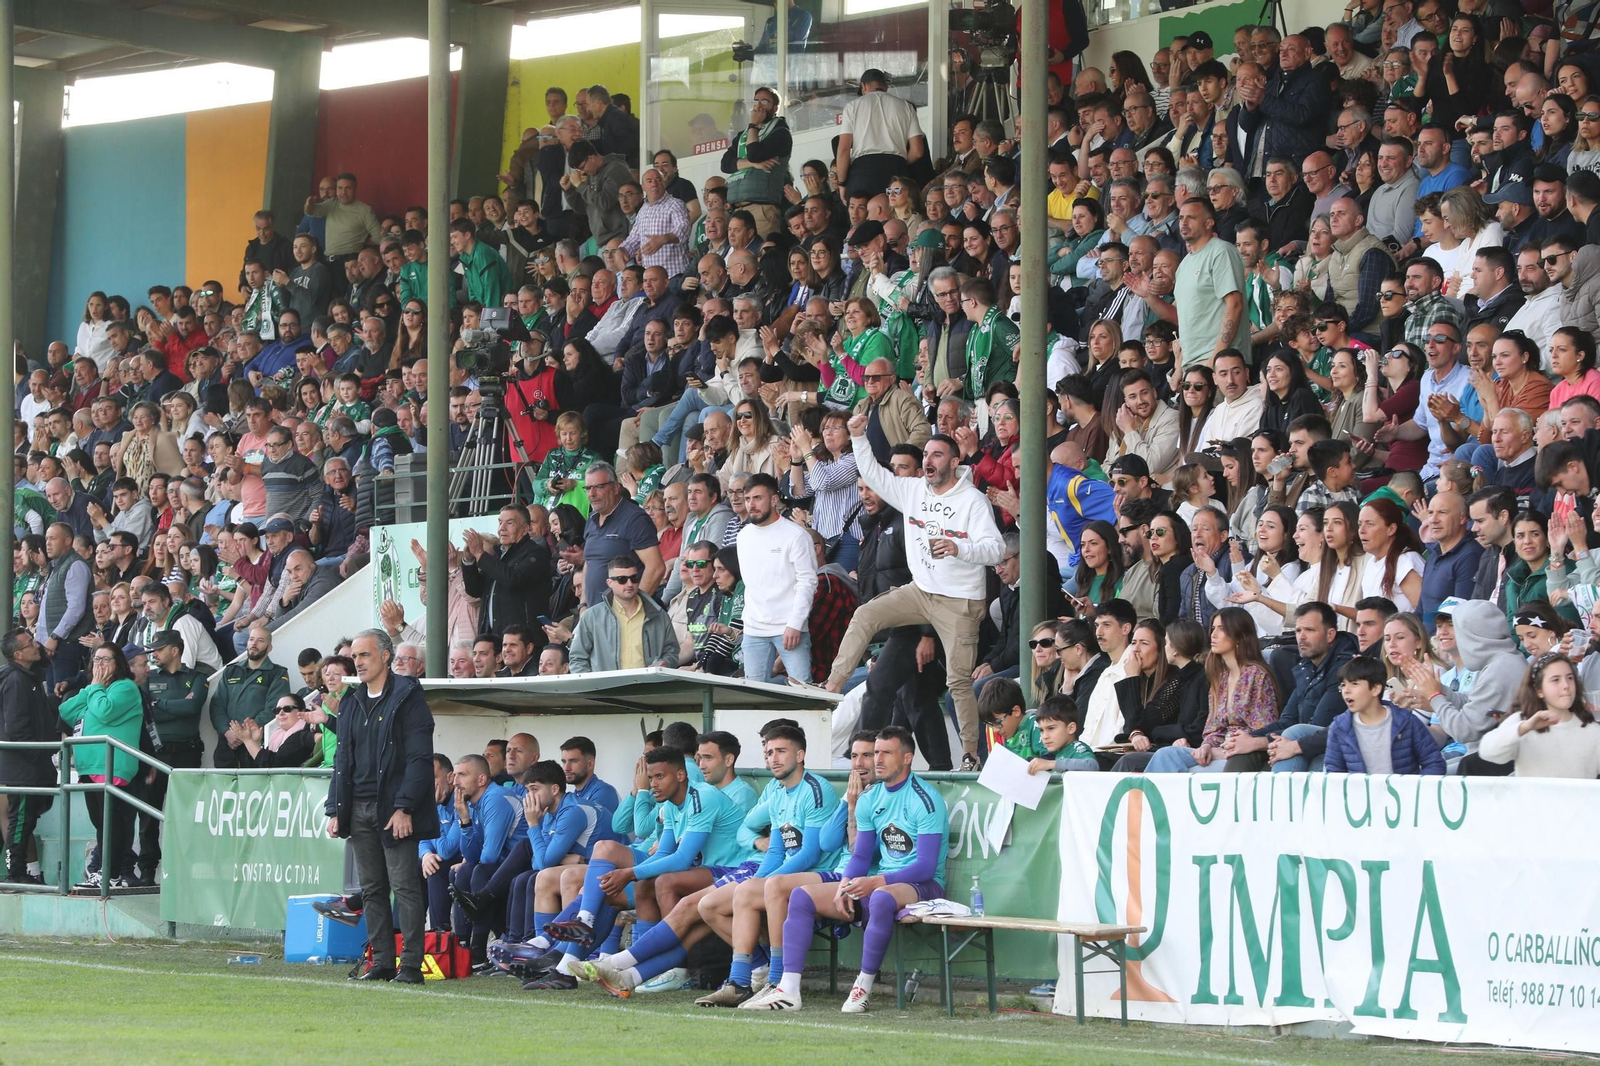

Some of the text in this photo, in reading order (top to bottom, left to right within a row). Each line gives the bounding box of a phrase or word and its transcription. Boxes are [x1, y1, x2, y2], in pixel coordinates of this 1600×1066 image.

[695, 139, 727, 155] PRENSA
[208, 789, 273, 838] ORECO
[1488, 928, 1600, 967] O CARBALLIÑO
[1487, 979, 1600, 1009] Teléf. 988 27 10 1
